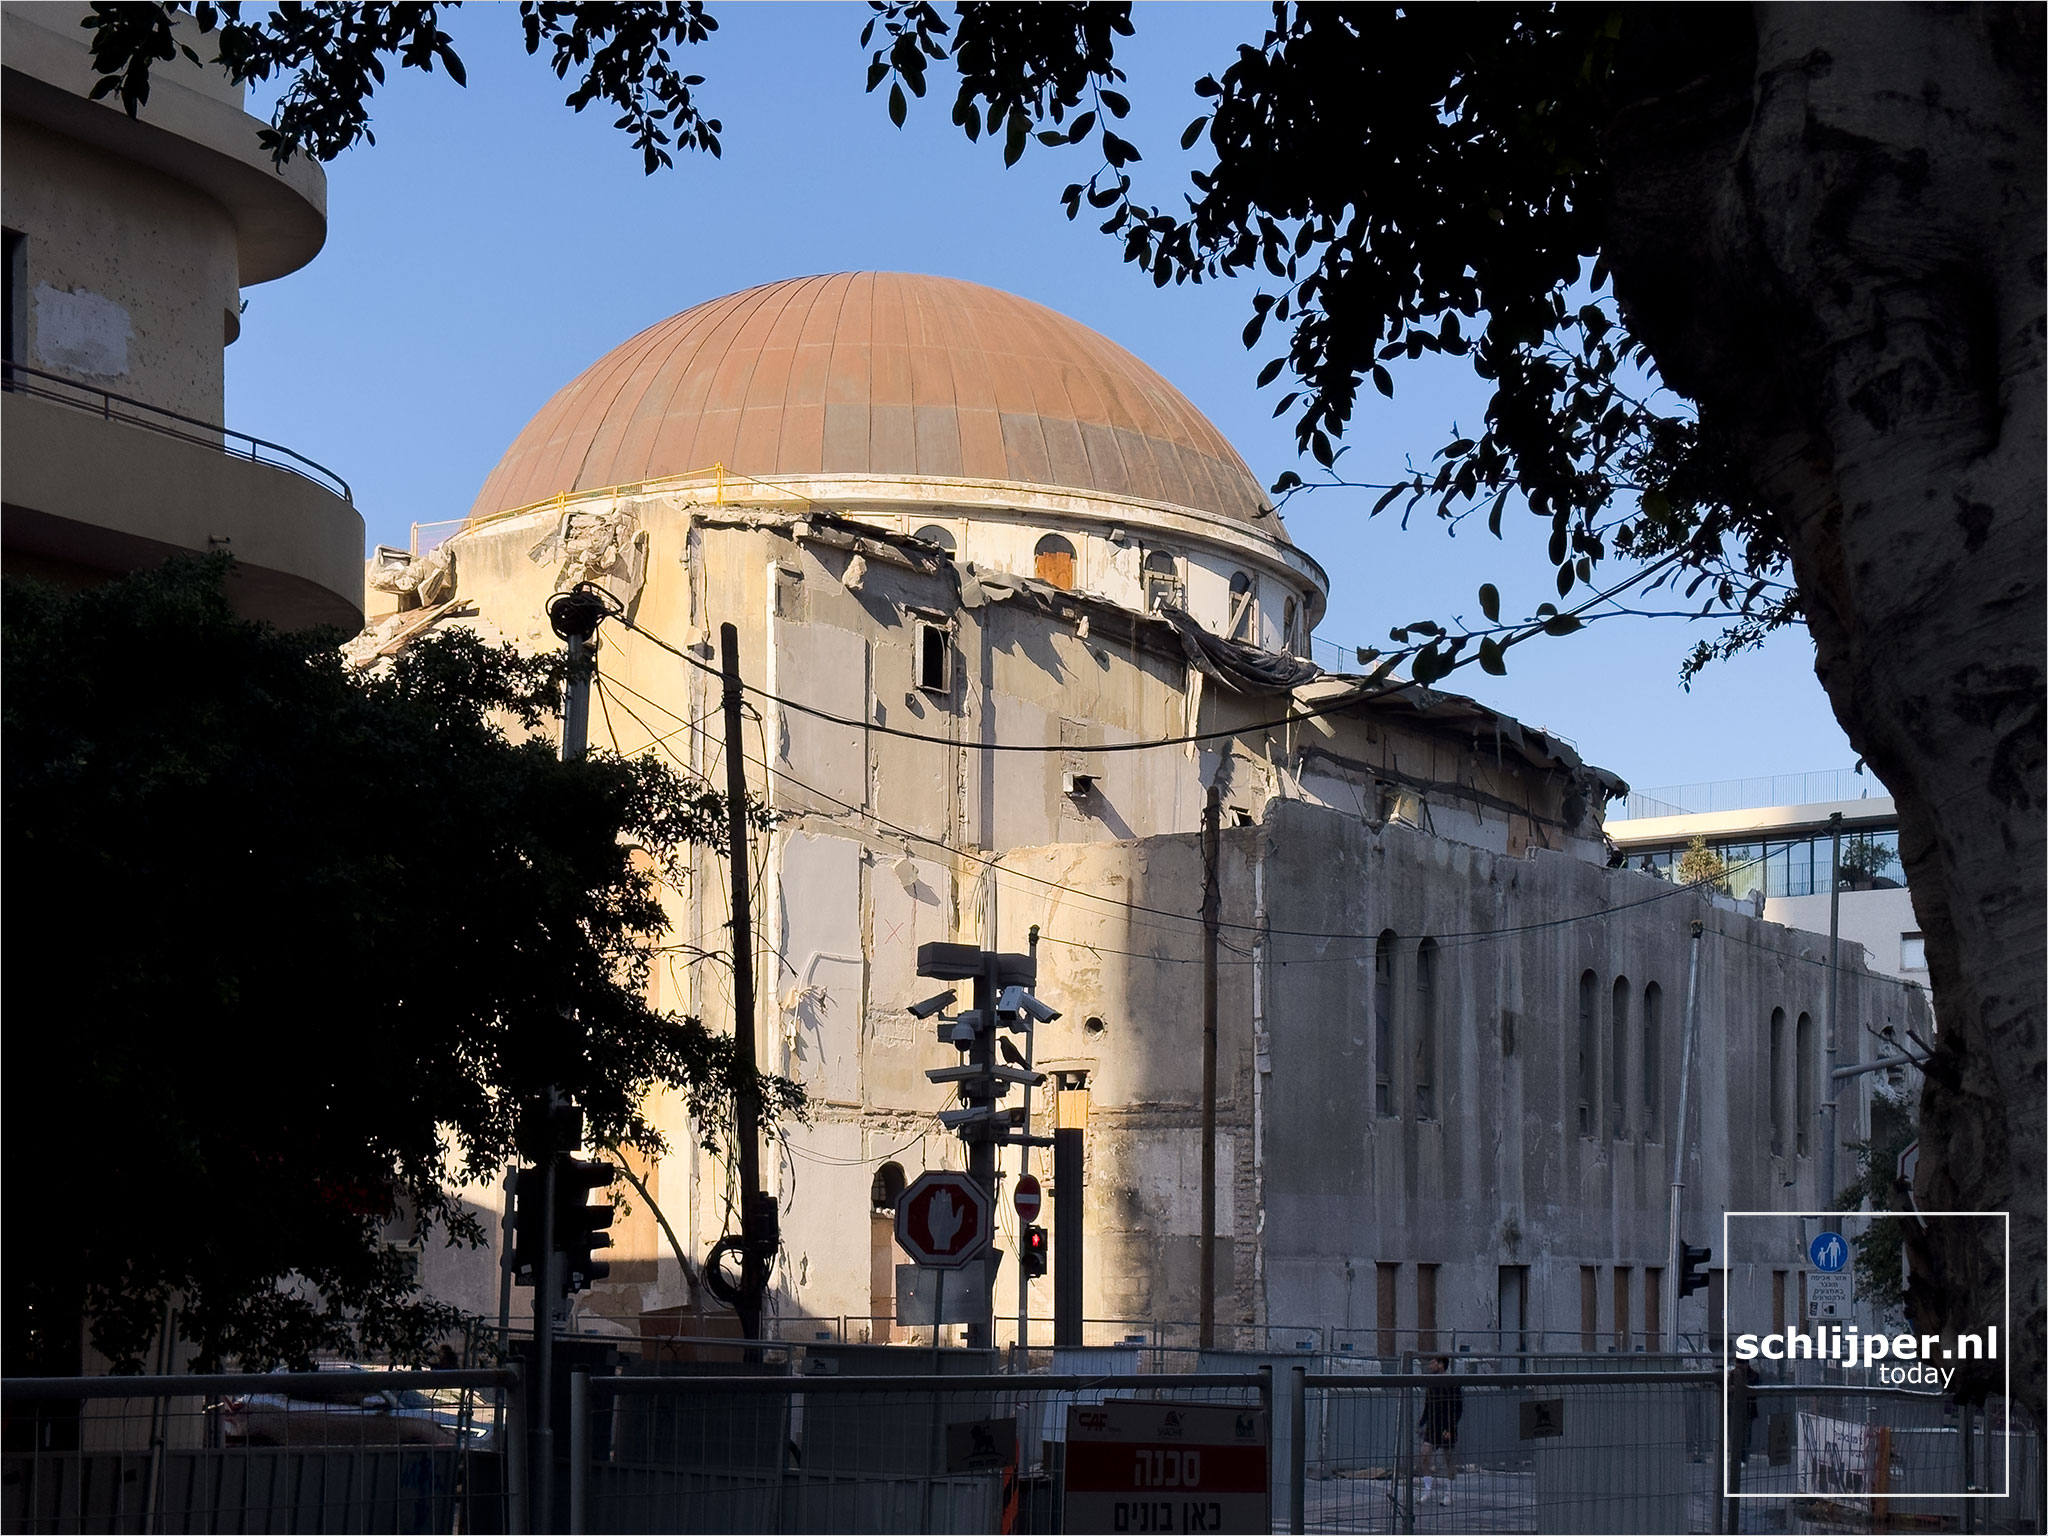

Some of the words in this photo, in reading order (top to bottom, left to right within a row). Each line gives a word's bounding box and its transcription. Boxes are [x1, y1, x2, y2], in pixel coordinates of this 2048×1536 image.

[1079, 1412, 1108, 1431] CAF
[1135, 1450, 1200, 1487] סכנה
[1114, 1502, 1173, 1531] בונים
[1183, 1502, 1222, 1535] כאן
